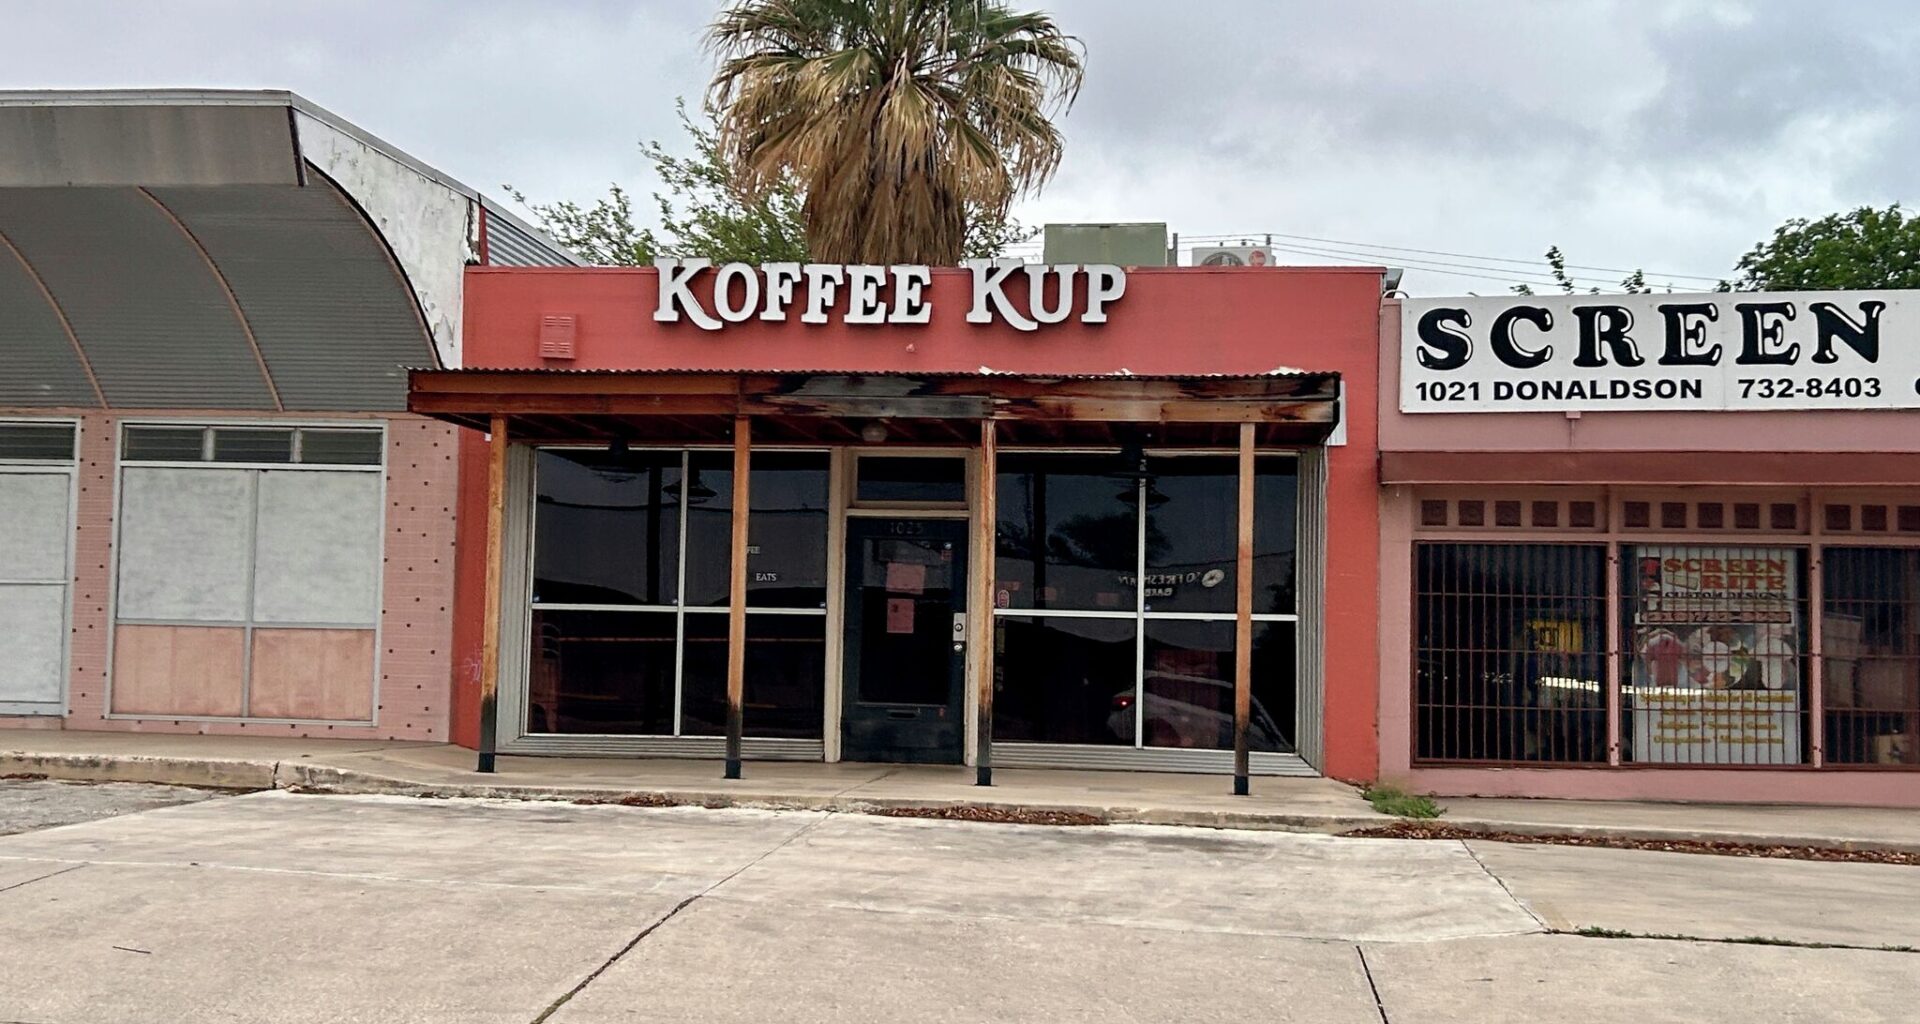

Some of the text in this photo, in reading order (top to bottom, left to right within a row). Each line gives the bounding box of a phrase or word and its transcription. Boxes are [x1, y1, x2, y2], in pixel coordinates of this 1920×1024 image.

[653, 257, 1127, 332] KOFFEE KUP
[1416, 300, 1887, 370] SCREEN
[1415, 376, 1882, 401] 1021 DONALDSON 732-8403
[755, 572, 777, 582] EATS
[1663, 558, 1787, 574] SCREEN
